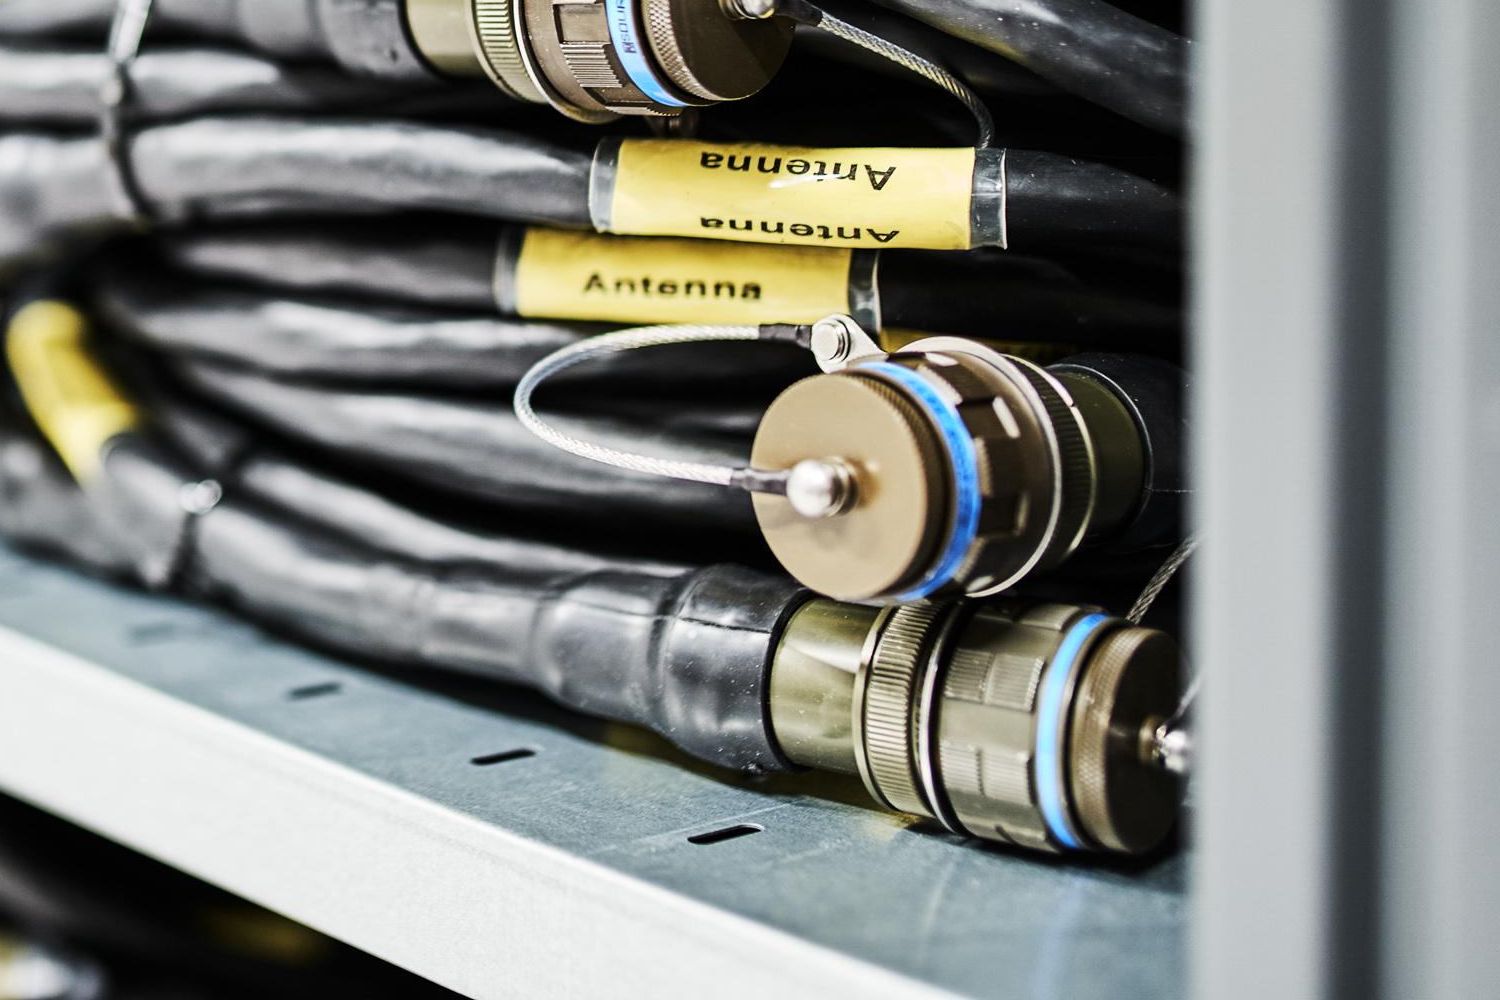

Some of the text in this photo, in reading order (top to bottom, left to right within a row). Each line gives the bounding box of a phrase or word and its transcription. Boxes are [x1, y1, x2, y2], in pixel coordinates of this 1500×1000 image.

[700, 152, 897, 191] Antenna
[700, 217, 900, 243] Antenna
[584, 271, 762, 300] Antenna
